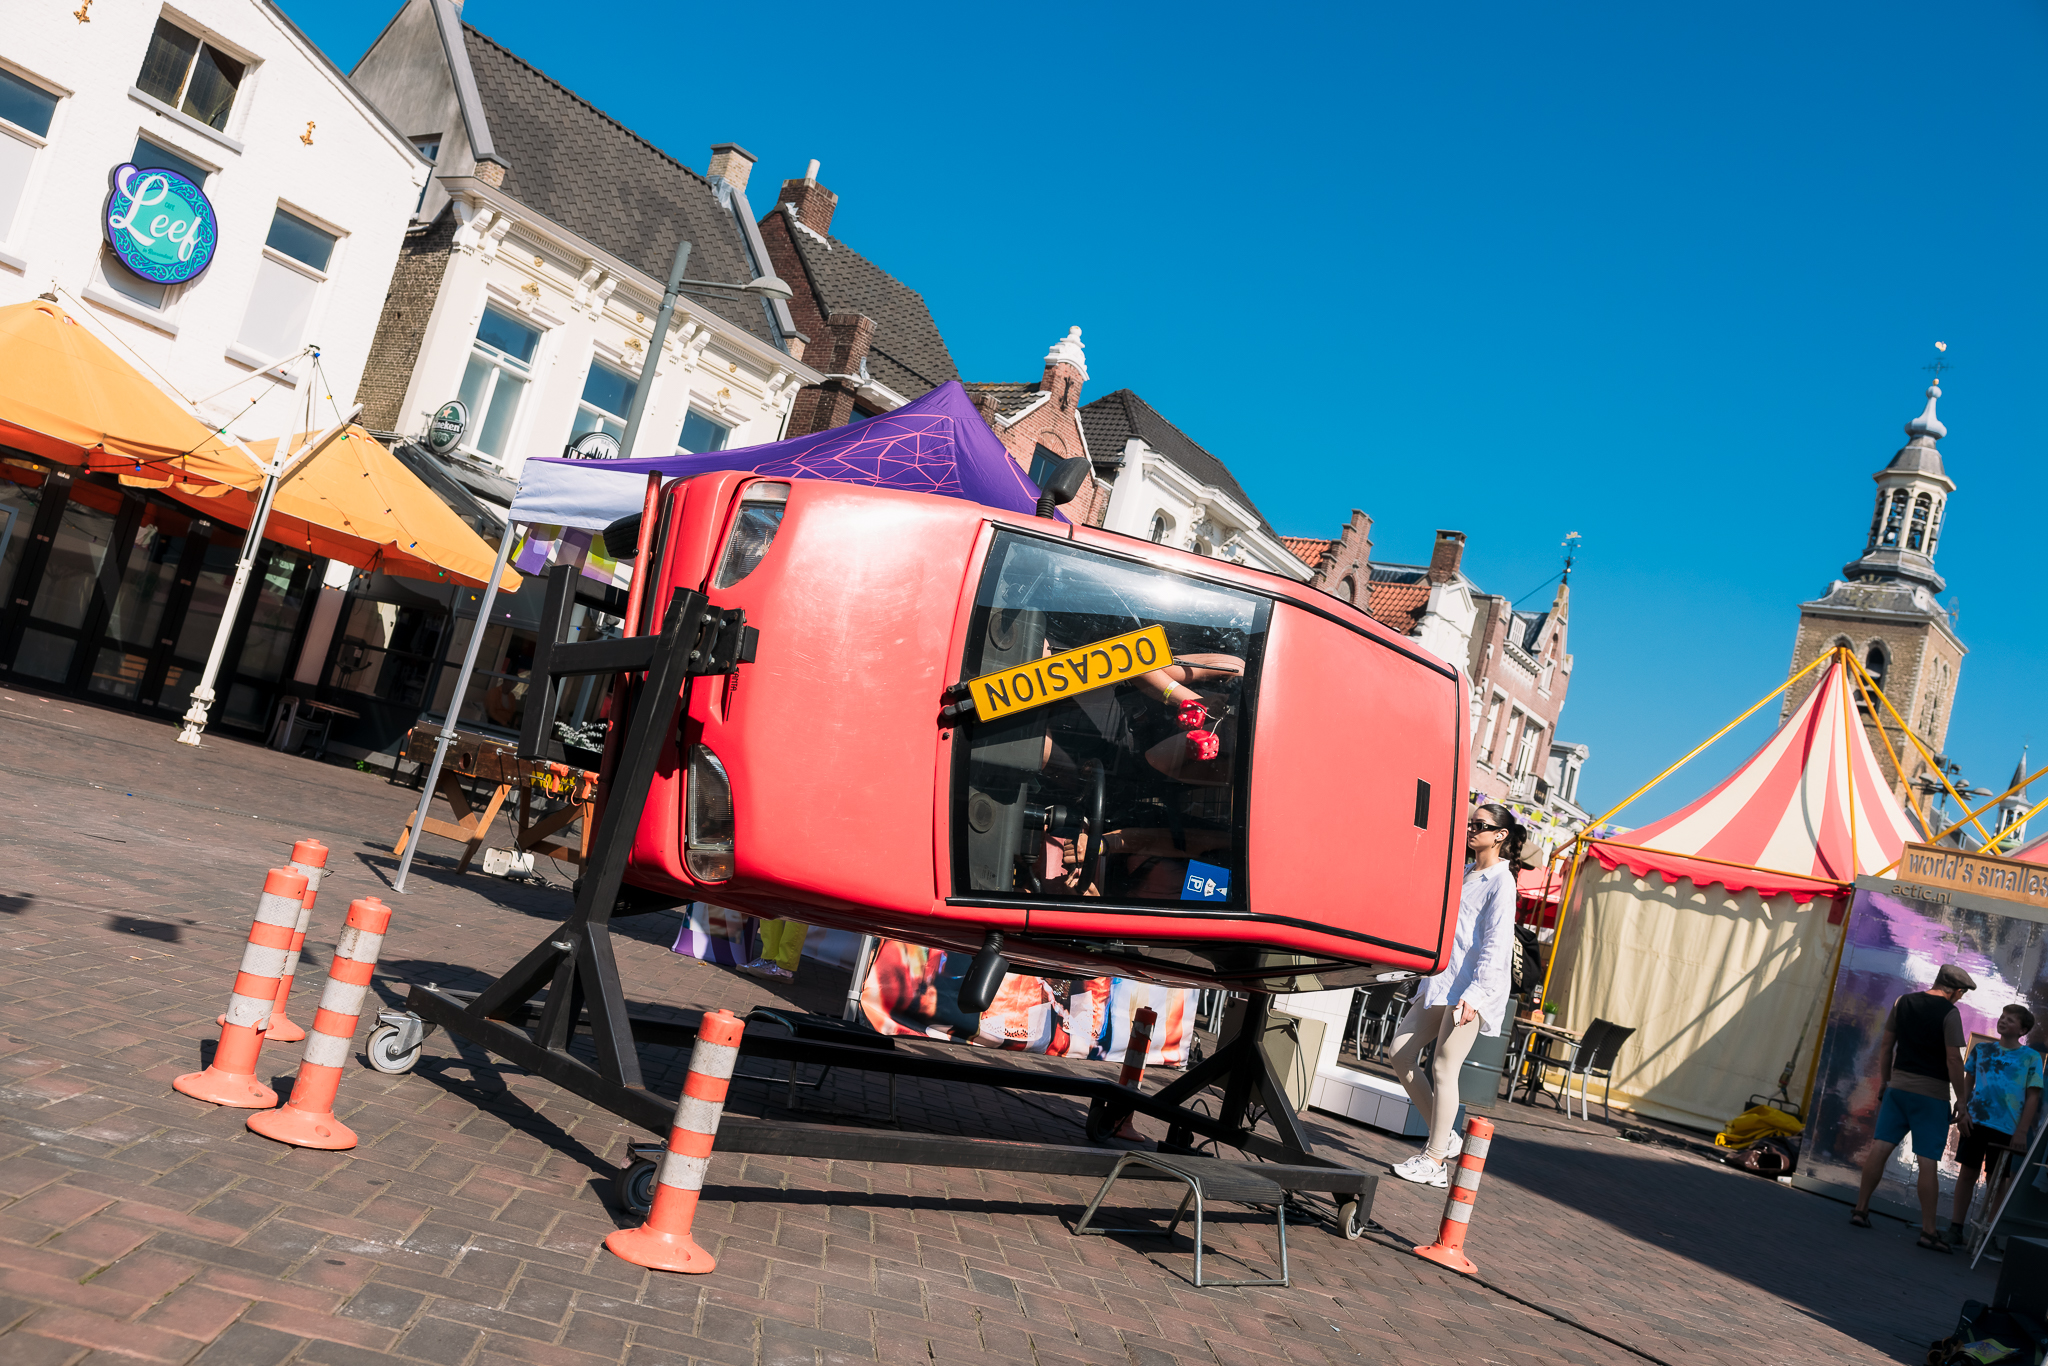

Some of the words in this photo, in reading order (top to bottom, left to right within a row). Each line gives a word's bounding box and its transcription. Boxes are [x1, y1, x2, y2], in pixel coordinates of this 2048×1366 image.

[109, 166, 203, 262] Leef
[984, 635, 1157, 711] OCCASION
[1891, 883, 1953, 905] actic.nl
[1909, 853, 1974, 884] world's
